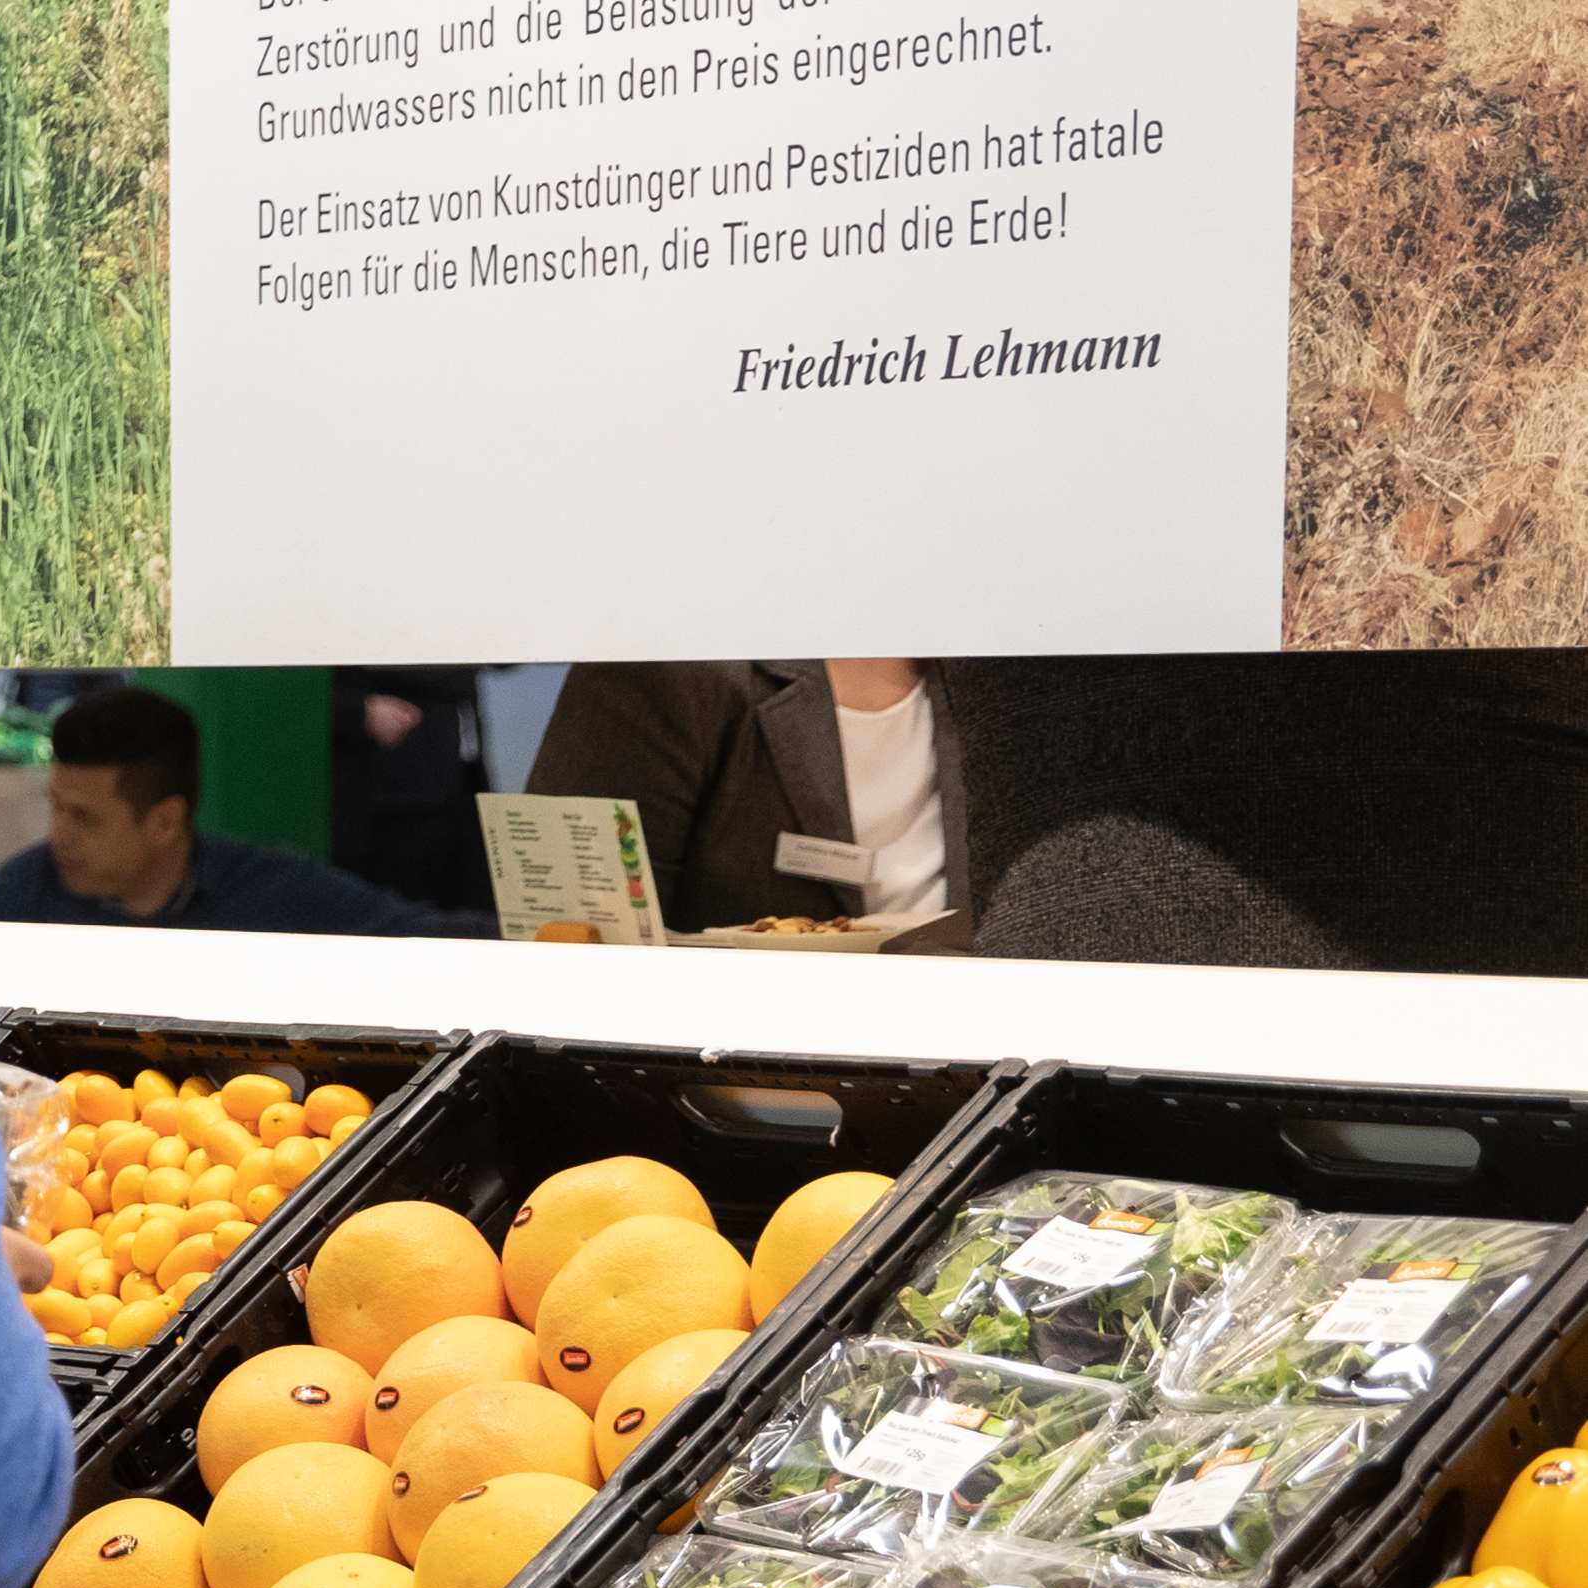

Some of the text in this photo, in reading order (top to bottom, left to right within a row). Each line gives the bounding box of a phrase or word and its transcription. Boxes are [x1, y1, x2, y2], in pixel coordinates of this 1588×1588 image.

[258, 27, 417, 76] Zerstörung
[441, 6, 493, 53] und
[517, 0, 561, 43] die
[259, 14, 1051, 142] Grundwassers nicht in den Preis eingerechnet.
[259, 109, 1162, 239] Der Einsatz von Kunstdünger und Pestiziden hat fatale
[259, 192, 1066, 311] Folgen für die Menschen, die Tiere und die Erde!
[733, 328, 1161, 392] Friedrich Lehmann
